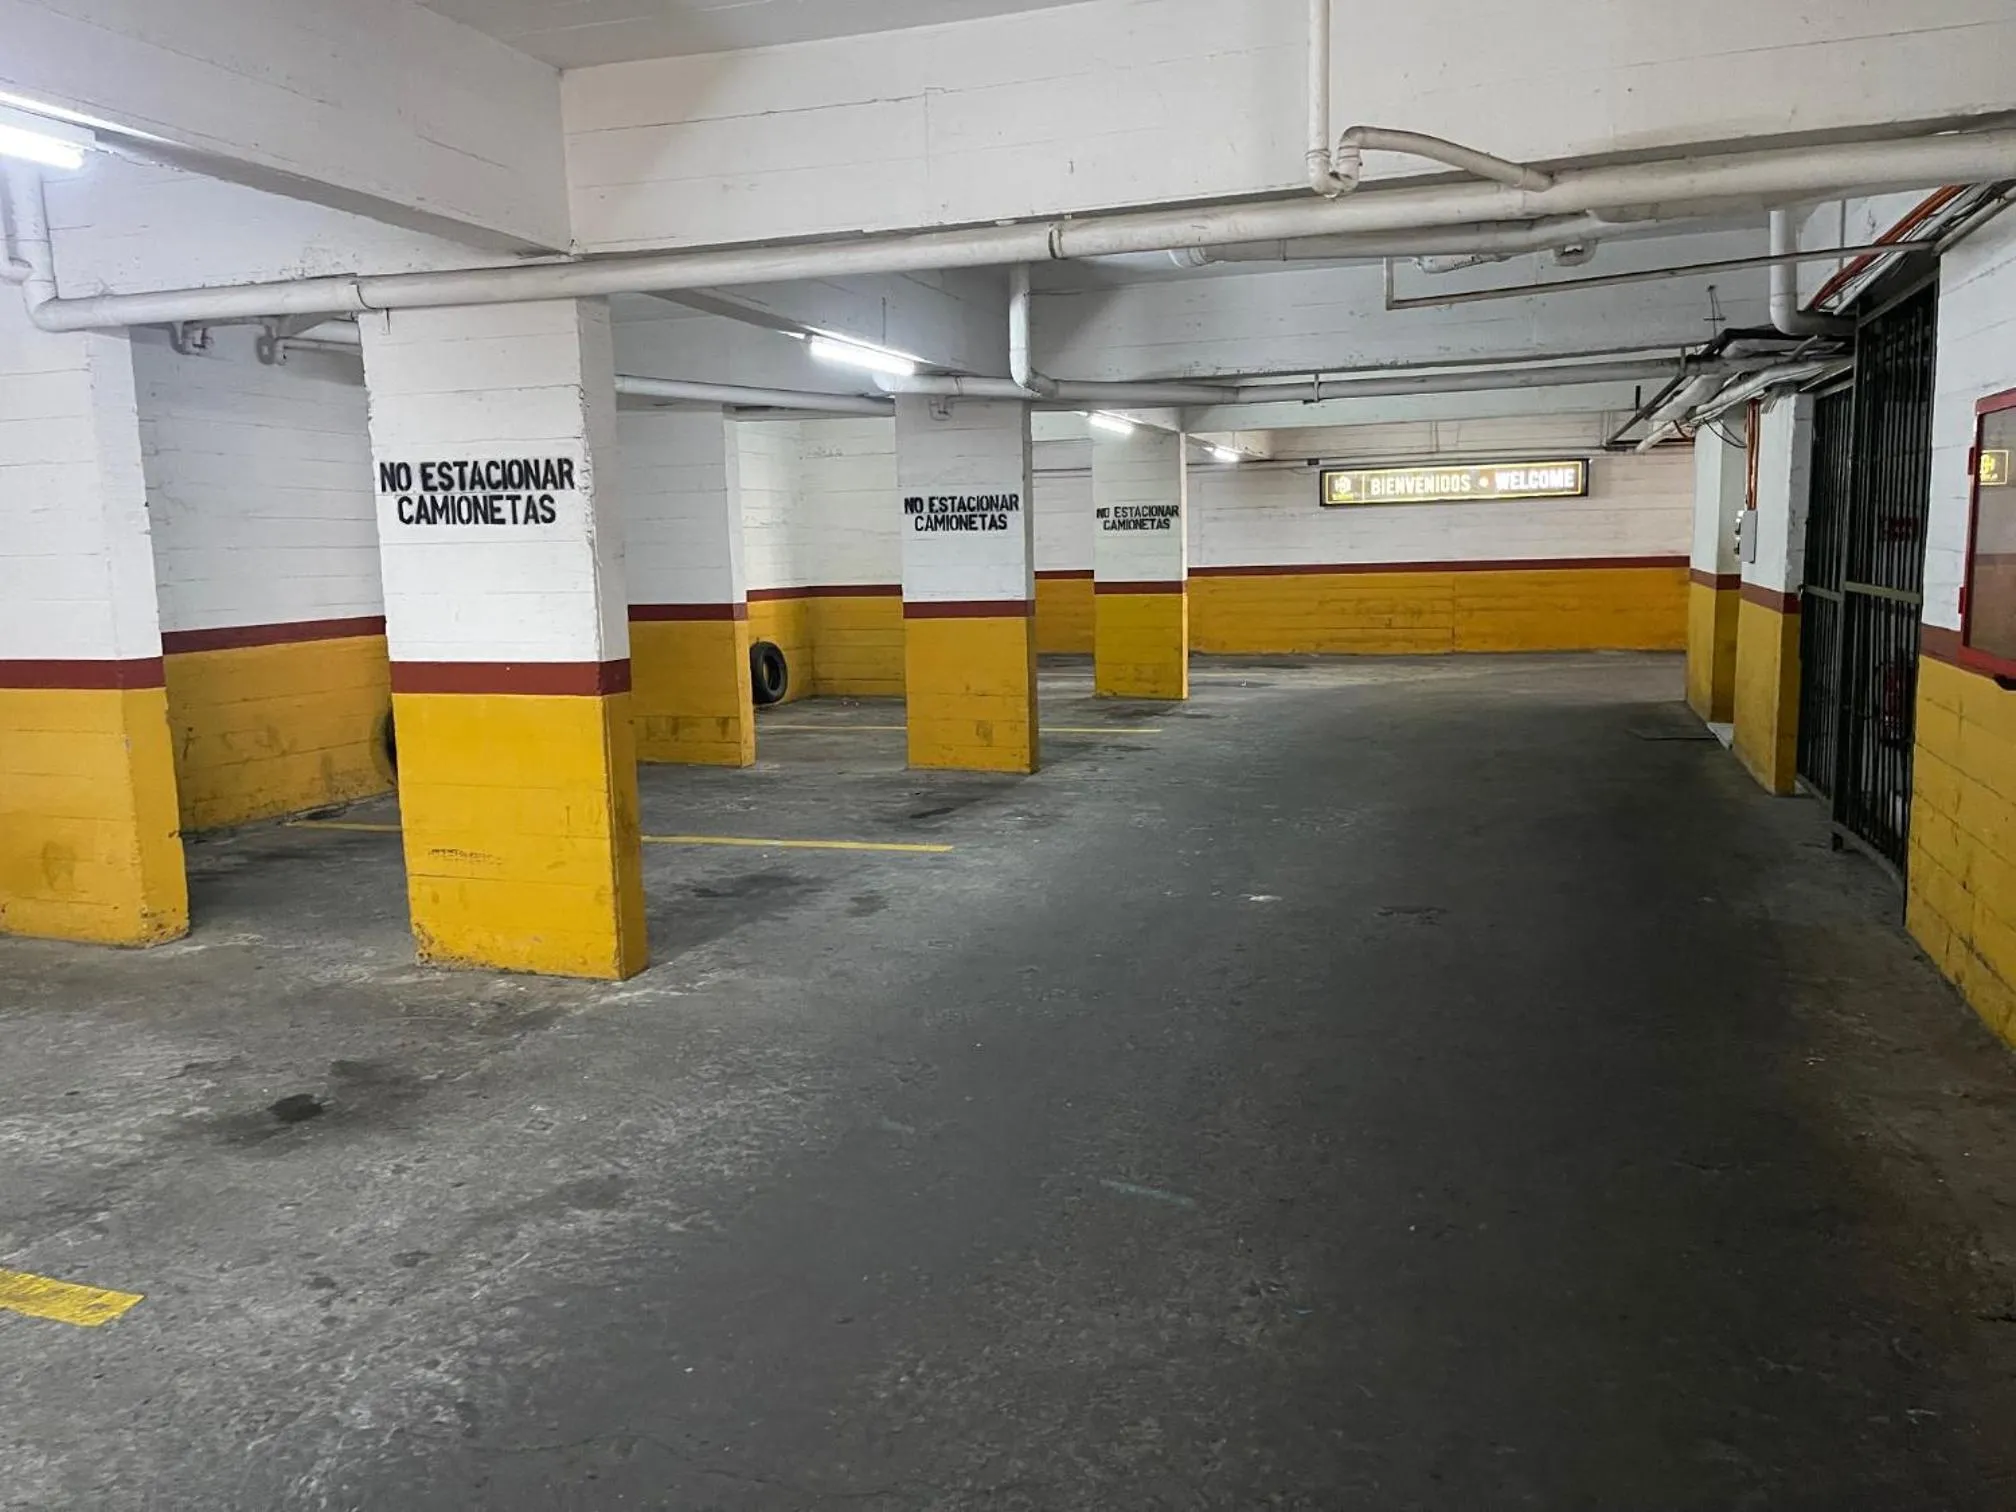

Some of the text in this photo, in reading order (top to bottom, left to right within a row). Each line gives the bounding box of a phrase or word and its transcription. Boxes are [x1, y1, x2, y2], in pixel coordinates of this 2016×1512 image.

[380, 458, 574, 492] NO ESTACIONAR
[1370, 468, 1575, 496] BIENVENIDOS WELCOME
[398, 495, 556, 524] CAMIONETAS
[904, 494, 1019, 514] NO ESTACIONAR
[1096, 505, 1179, 518] NO ESTACIONAR
[915, 514, 1007, 531] CAMIONETAS
[1103, 519, 1170, 530] CAMIONETAS
